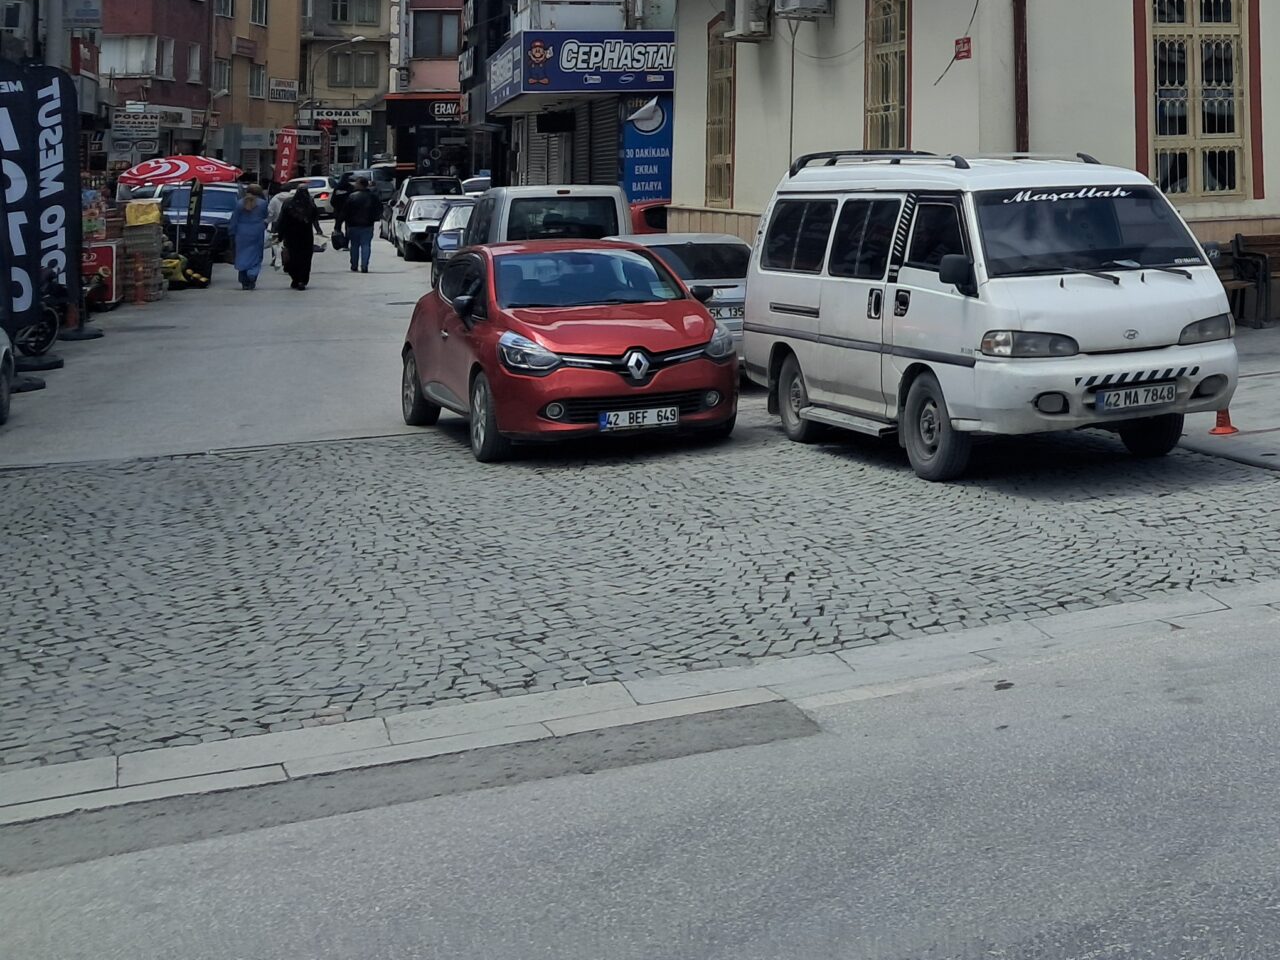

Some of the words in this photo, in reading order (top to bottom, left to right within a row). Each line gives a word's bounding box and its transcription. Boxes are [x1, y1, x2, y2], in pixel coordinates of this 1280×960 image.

[625, 148, 634, 158] 30
[635, 146, 670, 158] DAKİKADA
[634, 165, 658, 175] EKRAN
[632, 182, 662, 191] BATARYA
[1003, 187, 1132, 204] Maşallah
[1105, 393, 1119, 407] 42
[1124, 391, 1139, 406] MA
[1143, 387, 1175, 403] 7848
[606, 413, 620, 426] 42
[628, 411, 648, 425] BEF
[656, 408, 677, 422] 649
